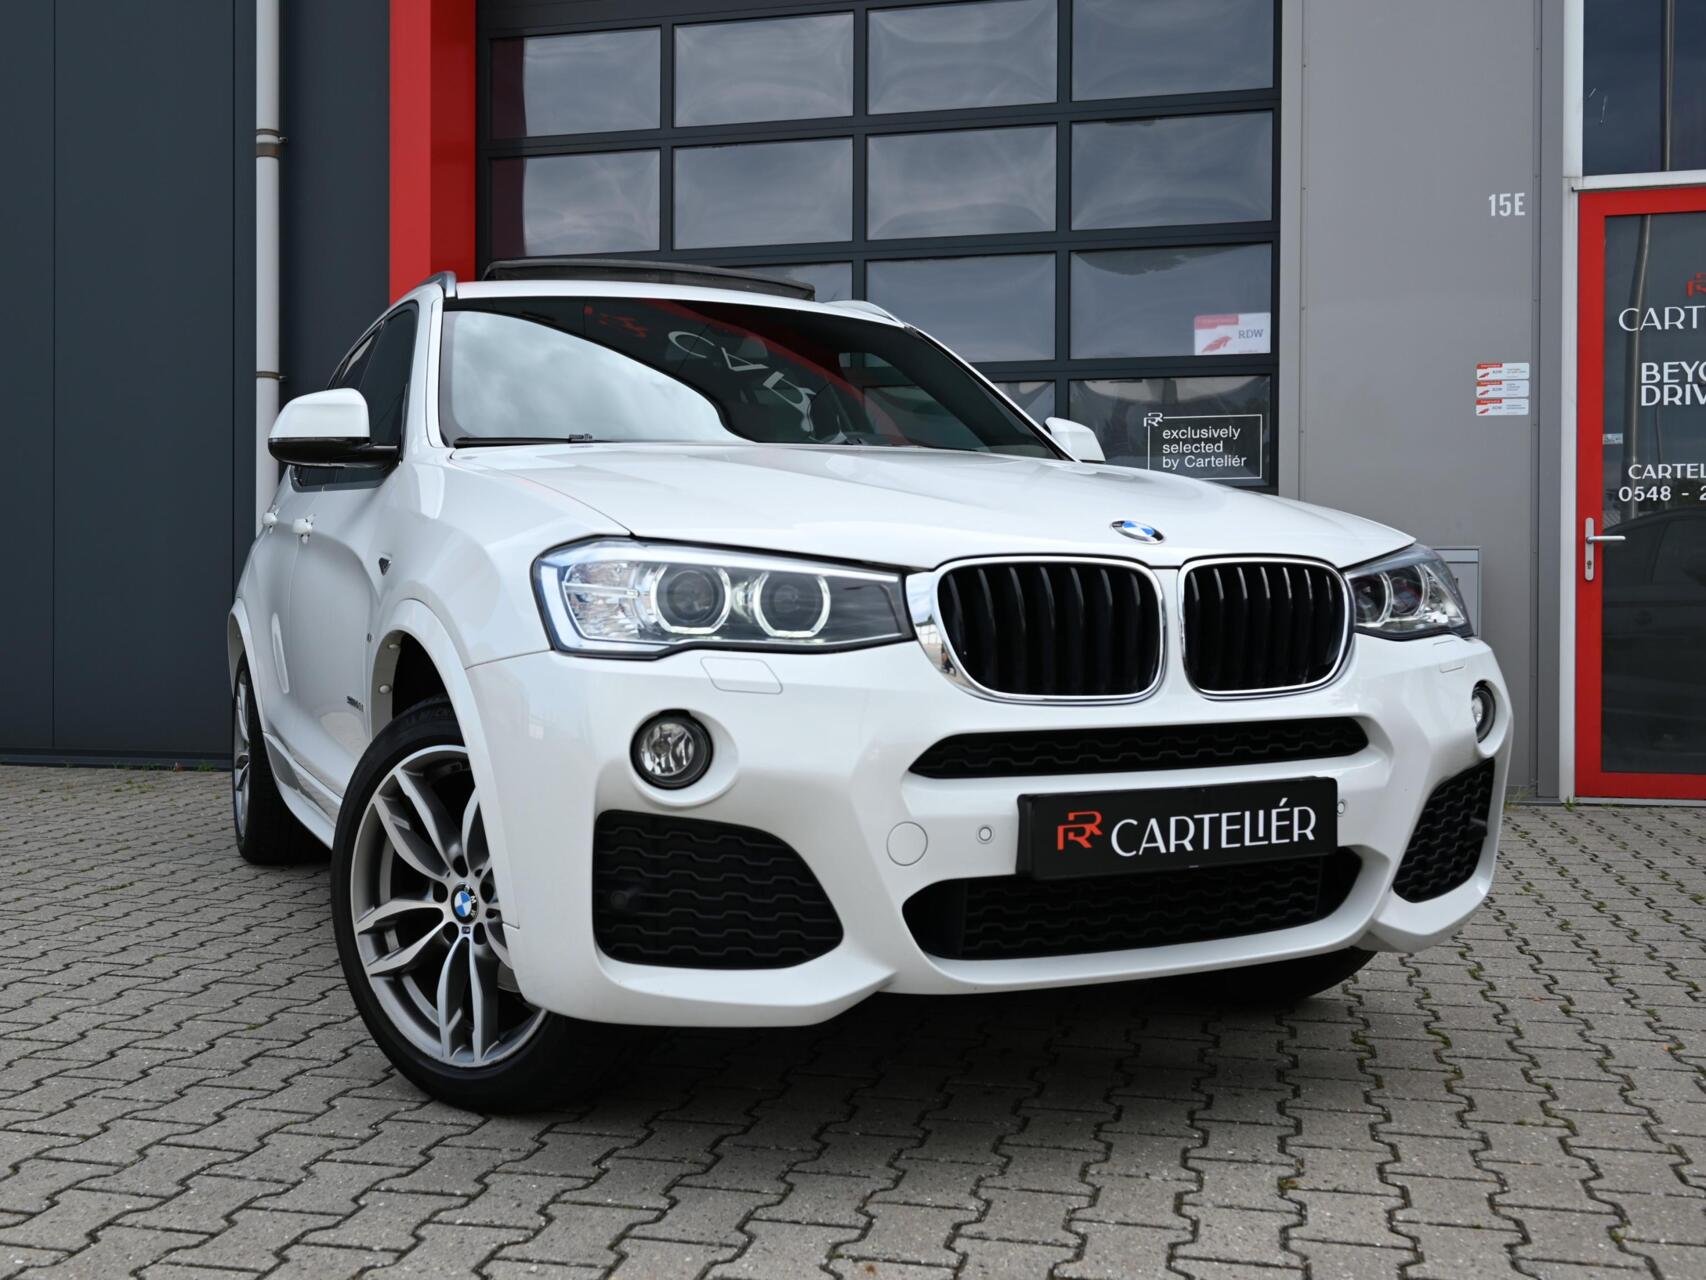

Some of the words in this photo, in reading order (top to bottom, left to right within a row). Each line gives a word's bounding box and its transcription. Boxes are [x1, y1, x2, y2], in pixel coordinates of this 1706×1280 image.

[1488, 192, 1526, 217] 15E
[1238, 329, 1264, 339] RDW
[1162, 425, 1241, 440] exclusively
[1162, 440, 1223, 454] selected
[1162, 456, 1180, 470] by
[1184, 454, 1247, 468] Carteliér
[1618, 485, 1672, 502] 0548
[1111, 798, 1317, 858] CARTELIÉR
